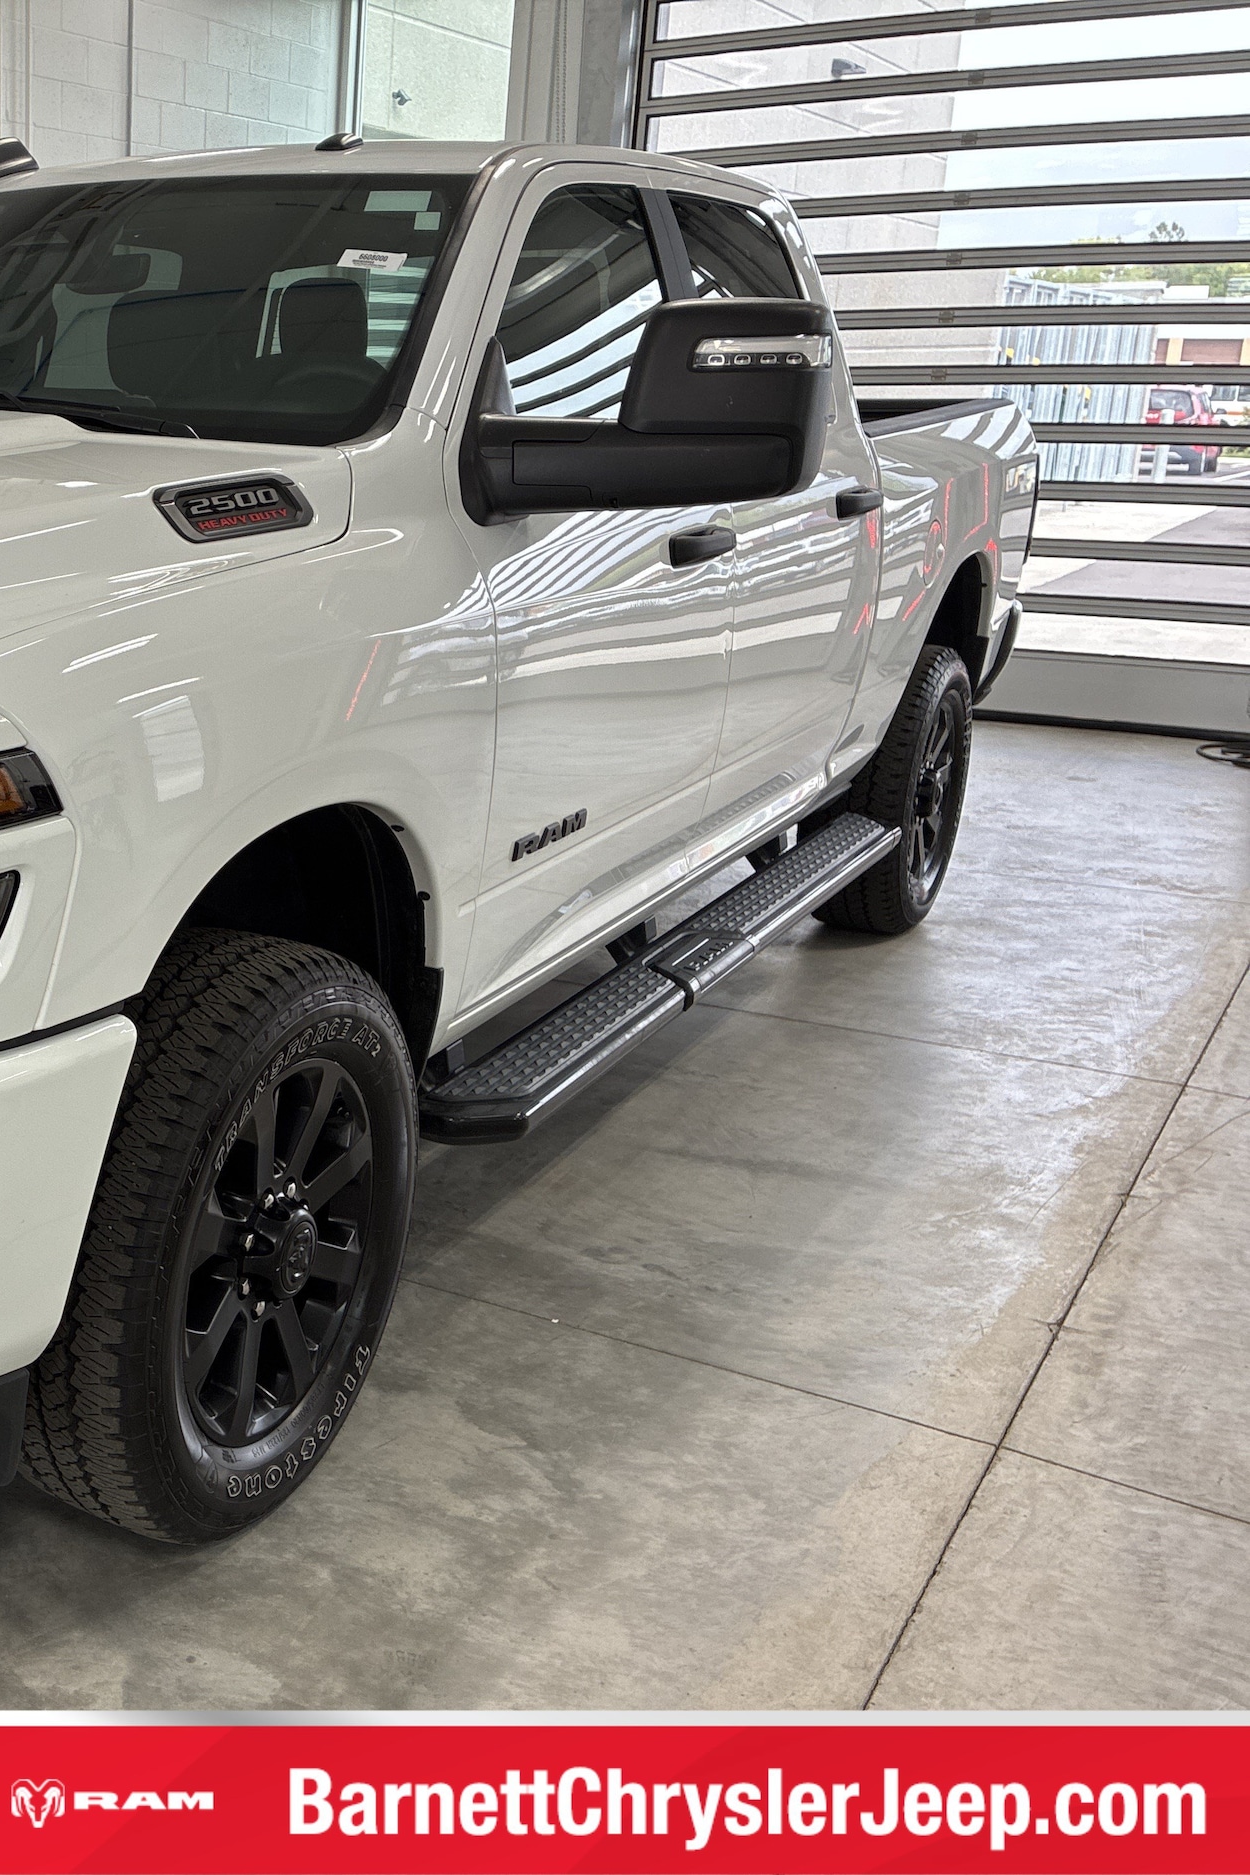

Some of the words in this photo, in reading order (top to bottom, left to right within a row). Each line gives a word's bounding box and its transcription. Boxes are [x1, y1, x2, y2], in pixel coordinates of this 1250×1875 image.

[188, 488, 279, 515] 2500
[198, 516, 248, 530] HEAVY
[249, 508, 288, 523] DUTY
[511, 808, 588, 862] RAM
[214, 1017, 353, 1172] TRANSFORCE
